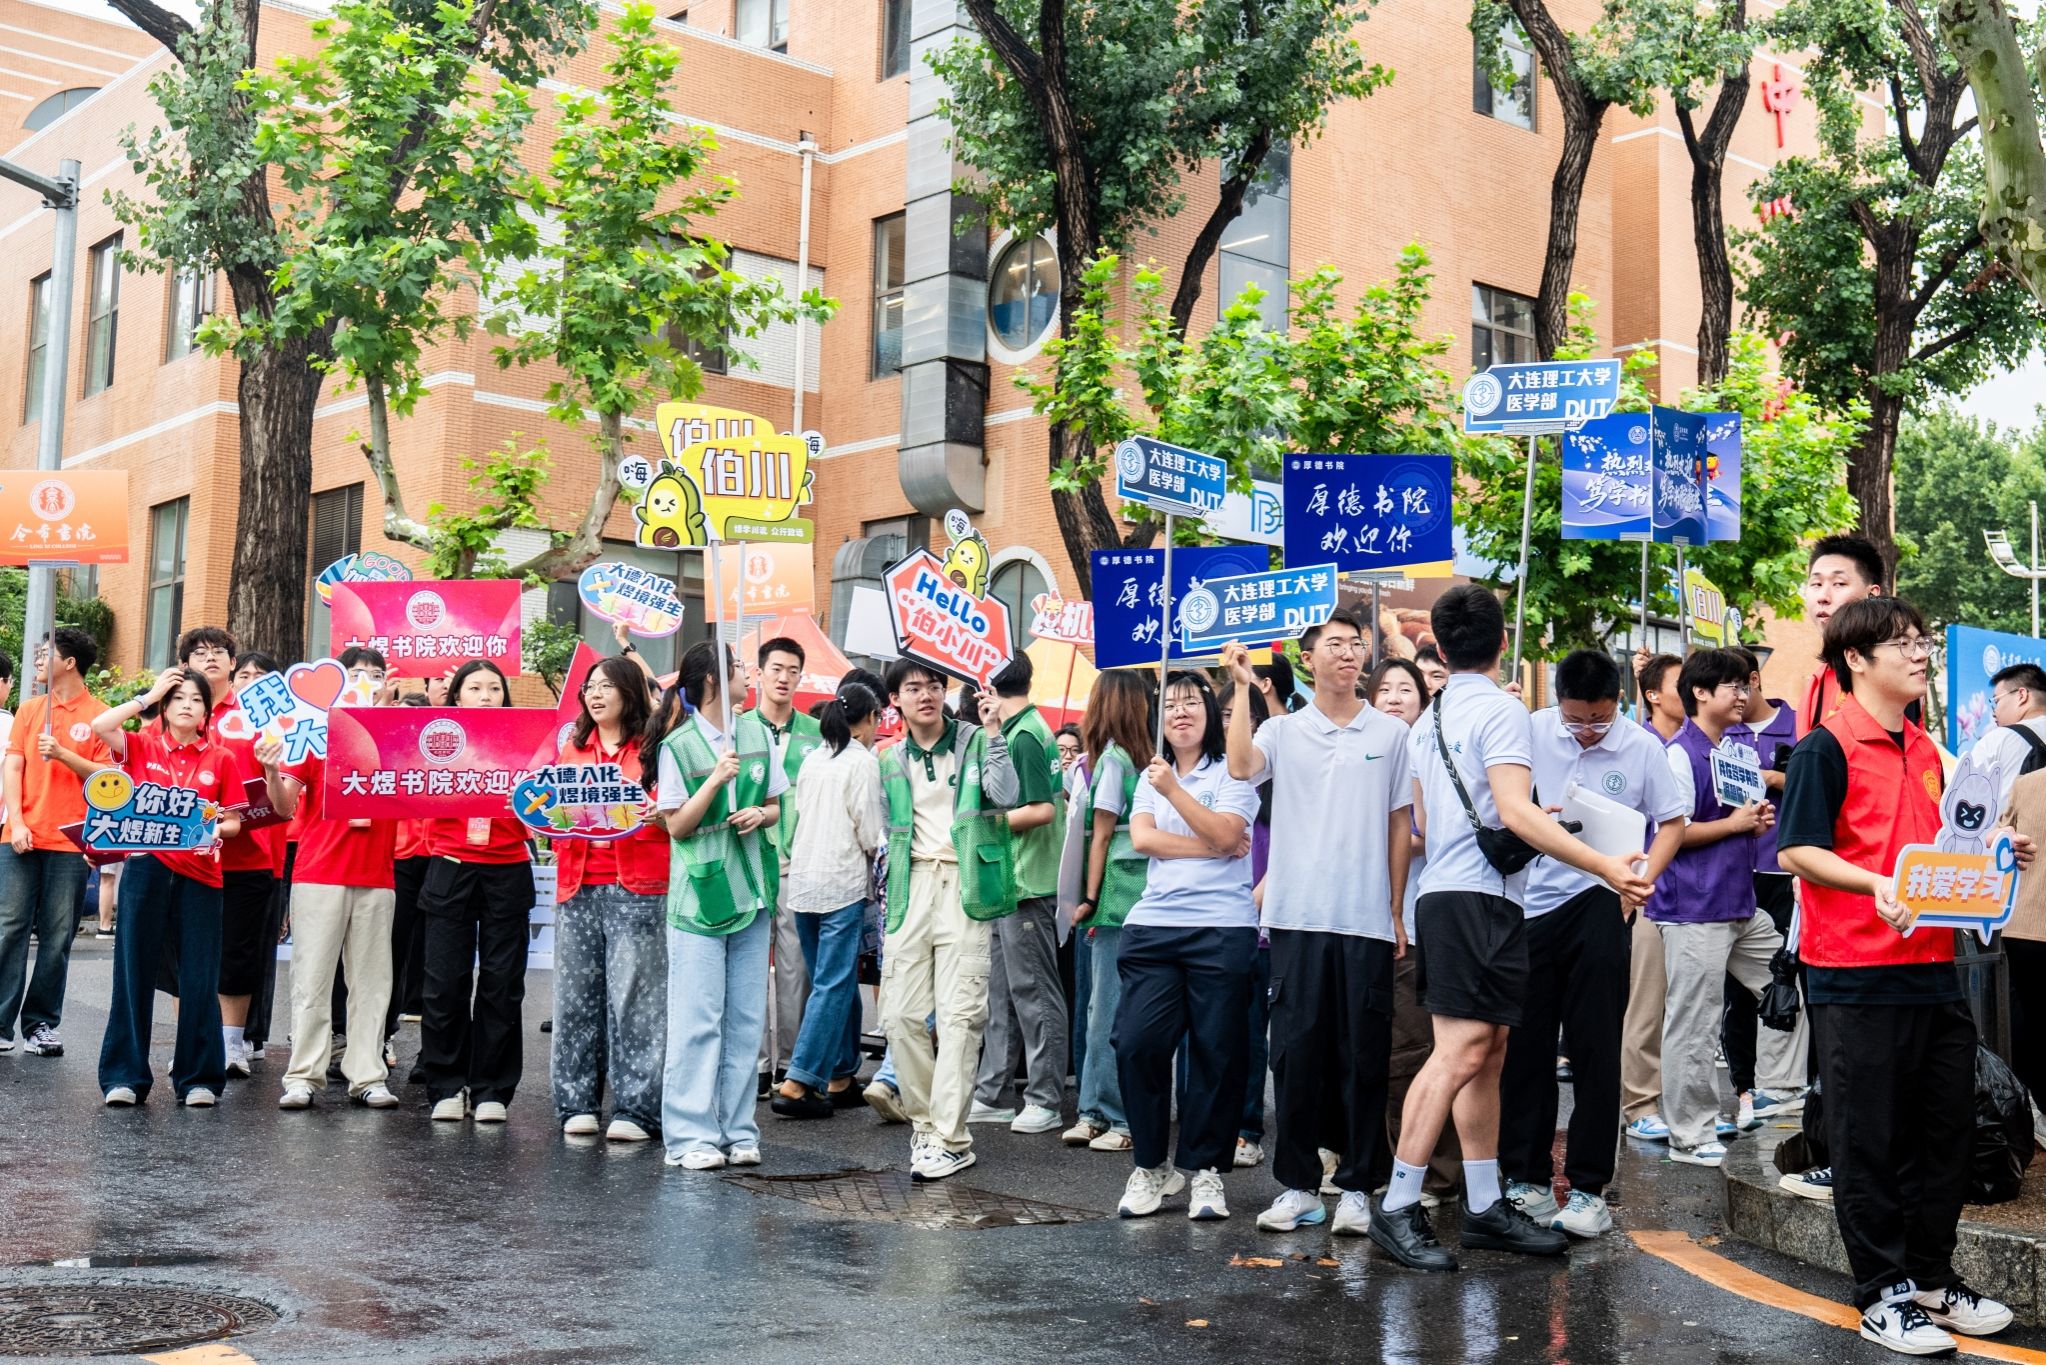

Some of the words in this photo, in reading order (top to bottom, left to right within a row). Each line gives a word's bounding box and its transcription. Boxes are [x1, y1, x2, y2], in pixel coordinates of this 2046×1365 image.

[1507, 367, 1611, 390] 大连理工大学
[1506, 393, 1557, 412] 医学部
[1565, 399, 1611, 419] DUT
[624, 461, 648, 484] 嗨
[700, 448, 791, 499] 伯川
[1150, 448, 1221, 482] 大连理工大学
[1303, 460, 1345, 471] 厚德书院
[1601, 450, 1650, 477] 热烈
[1149, 469, 1185, 494] 医学部
[1579, 471, 1650, 513] 笃学书
[1190, 487, 1222, 511] DUT
[1306, 482, 1431, 518] 厚德书院
[951, 515, 968, 535] 嗨
[1321, 523, 1413, 554] 欢迎你
[364, 555, 410, 582] GOOD
[1111, 555, 1155, 565] 厚德书院
[609, 564, 673, 595] 大德入化
[1224, 572, 1329, 604] 大连理工大学
[616, 582, 682, 617] 煜境强生
[917, 572, 986, 633] Hello
[1224, 603, 1276, 626] 医学部
[1691, 584, 1722, 627] 伯川
[1061, 601, 1094, 640] 机
[1284, 604, 1330, 629] DUT
[240, 674, 296, 728] 我
[285, 718, 327, 762] 大
[537, 765, 620, 785] 大德入化
[135, 784, 197, 817] 你好
[559, 786, 644, 804] 煜境强生
[86, 815, 182, 846] 大煜新生
[1905, 863, 2005, 903] 我爱学习
